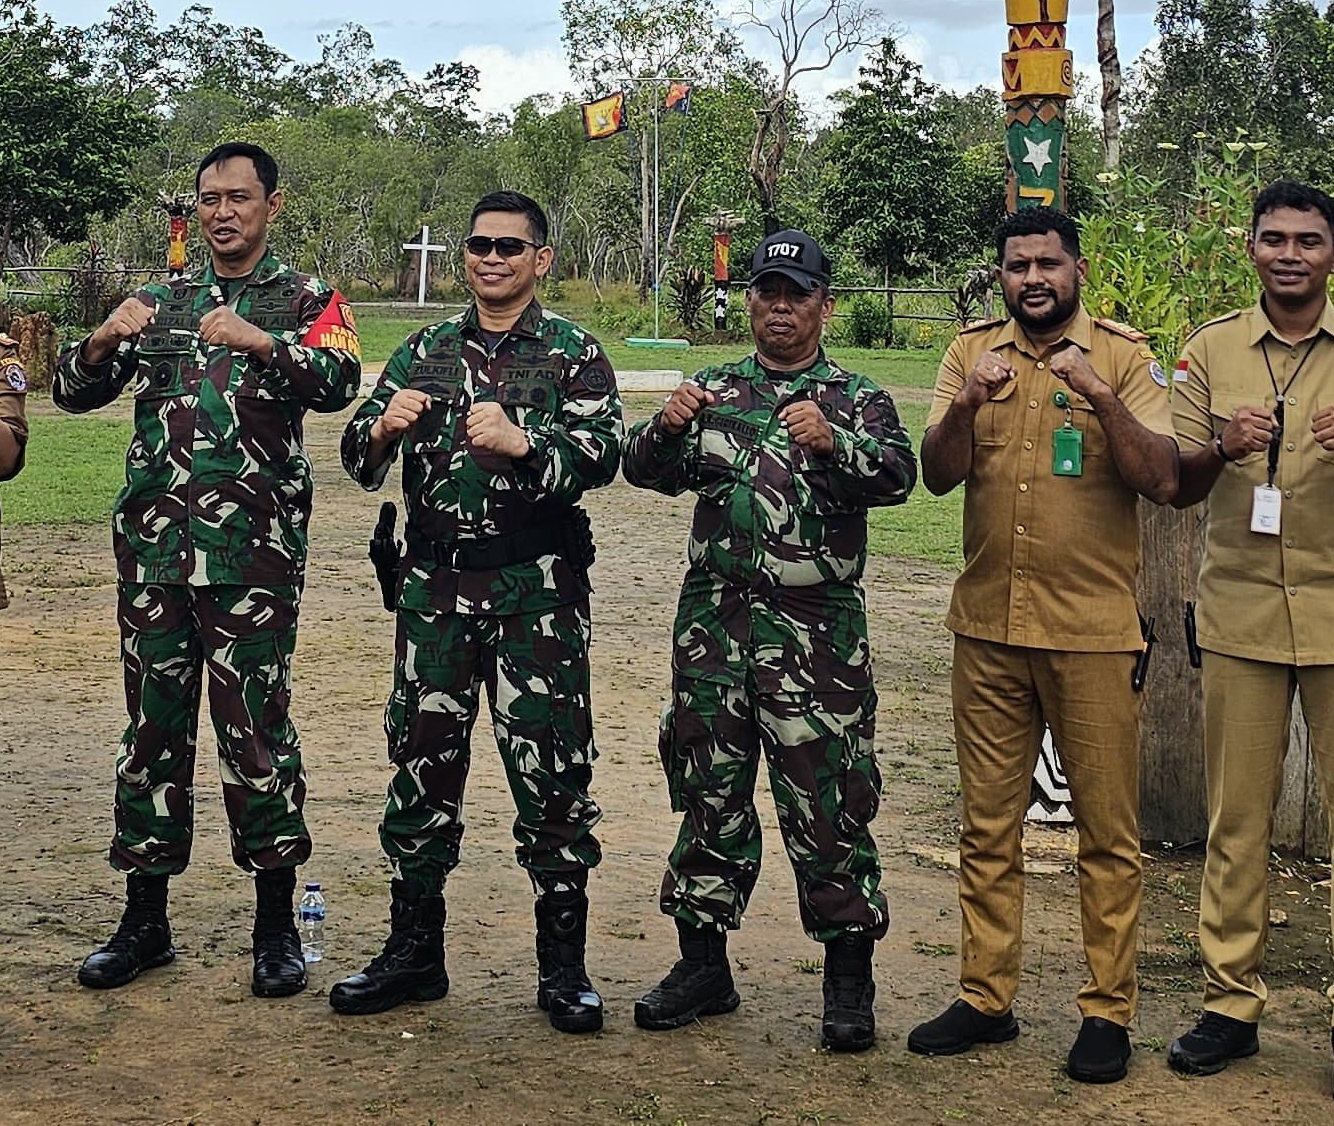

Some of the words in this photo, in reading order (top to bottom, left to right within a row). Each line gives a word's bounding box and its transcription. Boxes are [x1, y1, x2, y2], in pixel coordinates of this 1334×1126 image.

[767, 242, 800, 258] 1707
[415, 365, 458, 377] ZULKIFLI
[507, 369, 529, 379] TNI
[534, 369, 555, 380] AD
